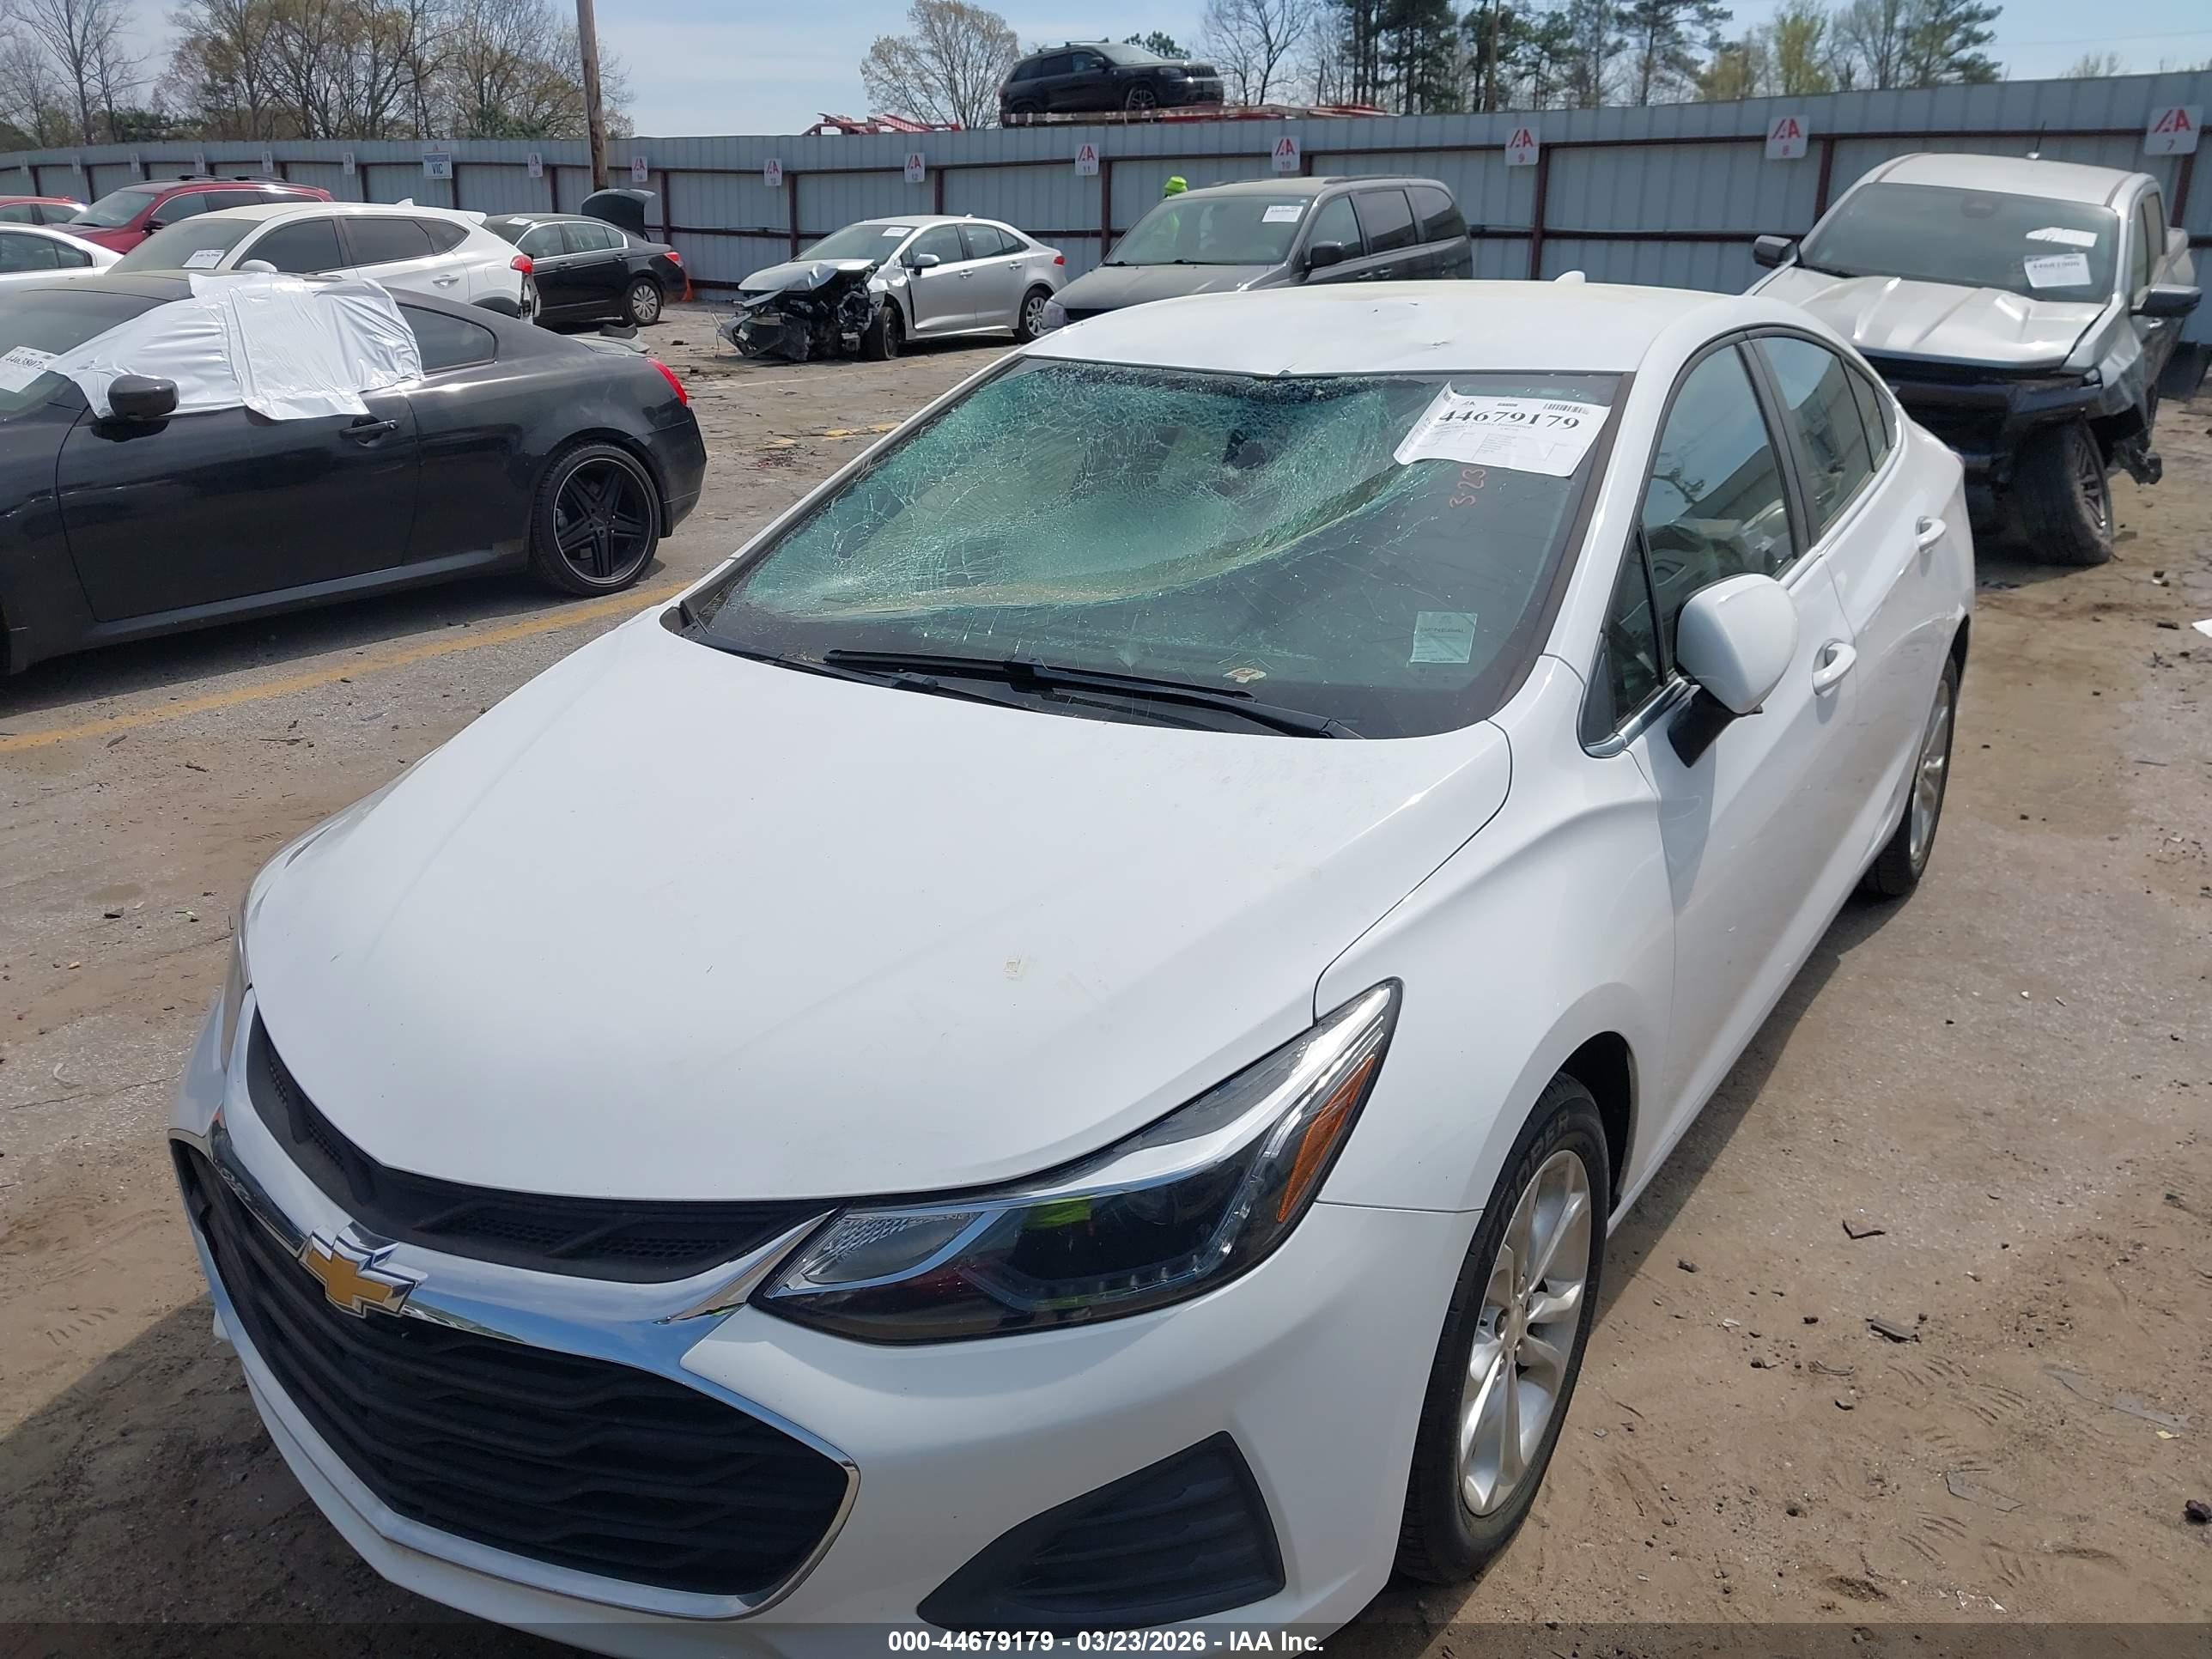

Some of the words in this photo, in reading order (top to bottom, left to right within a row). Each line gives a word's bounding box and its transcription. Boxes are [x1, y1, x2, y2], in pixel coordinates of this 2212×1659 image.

[2166, 138, 2175, 152] 7
[1517, 153, 1526, 163] 9
[431, 163, 444, 175] VIC
[1439, 410, 1580, 430] 44679179
